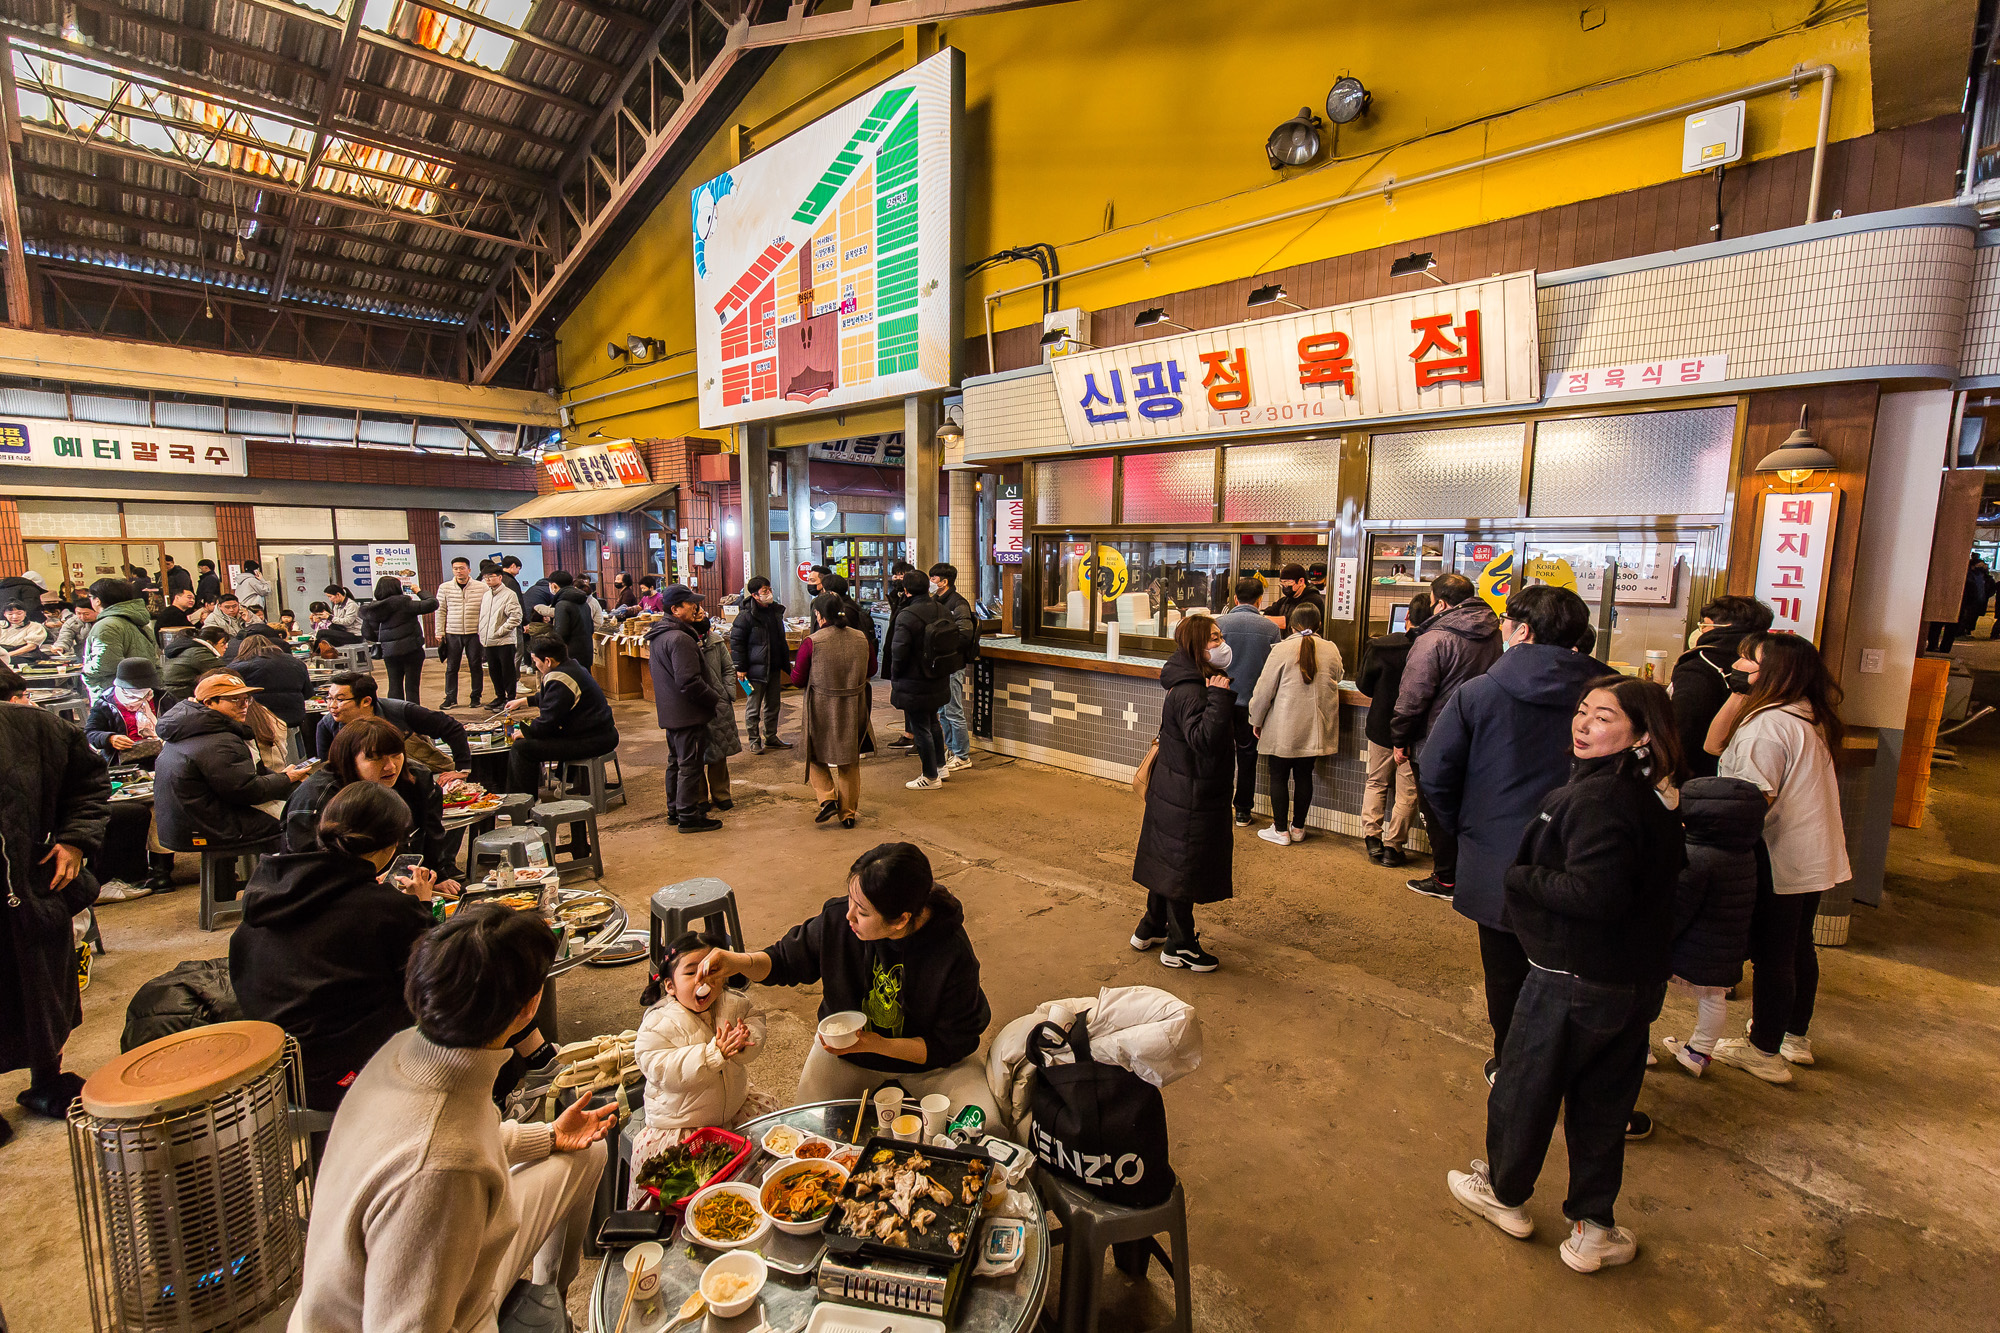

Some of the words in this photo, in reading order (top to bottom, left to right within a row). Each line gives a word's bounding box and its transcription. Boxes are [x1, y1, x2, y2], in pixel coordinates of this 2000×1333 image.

[798, 290, 814, 303] 현위치
[1078, 358, 1188, 425] 신광
[1198, 308, 1485, 413] 정육점
[1567, 359, 1706, 394] 정육식당
[53, 435, 122, 460] 예터
[131, 440, 230, 466] 칼국수
[567, 453, 618, 484] 대흥상회
[375, 548, 411, 556] 또복이네
[1536, 563, 1560, 571] KOREA
[1768, 500, 1814, 635] 돼지고기
